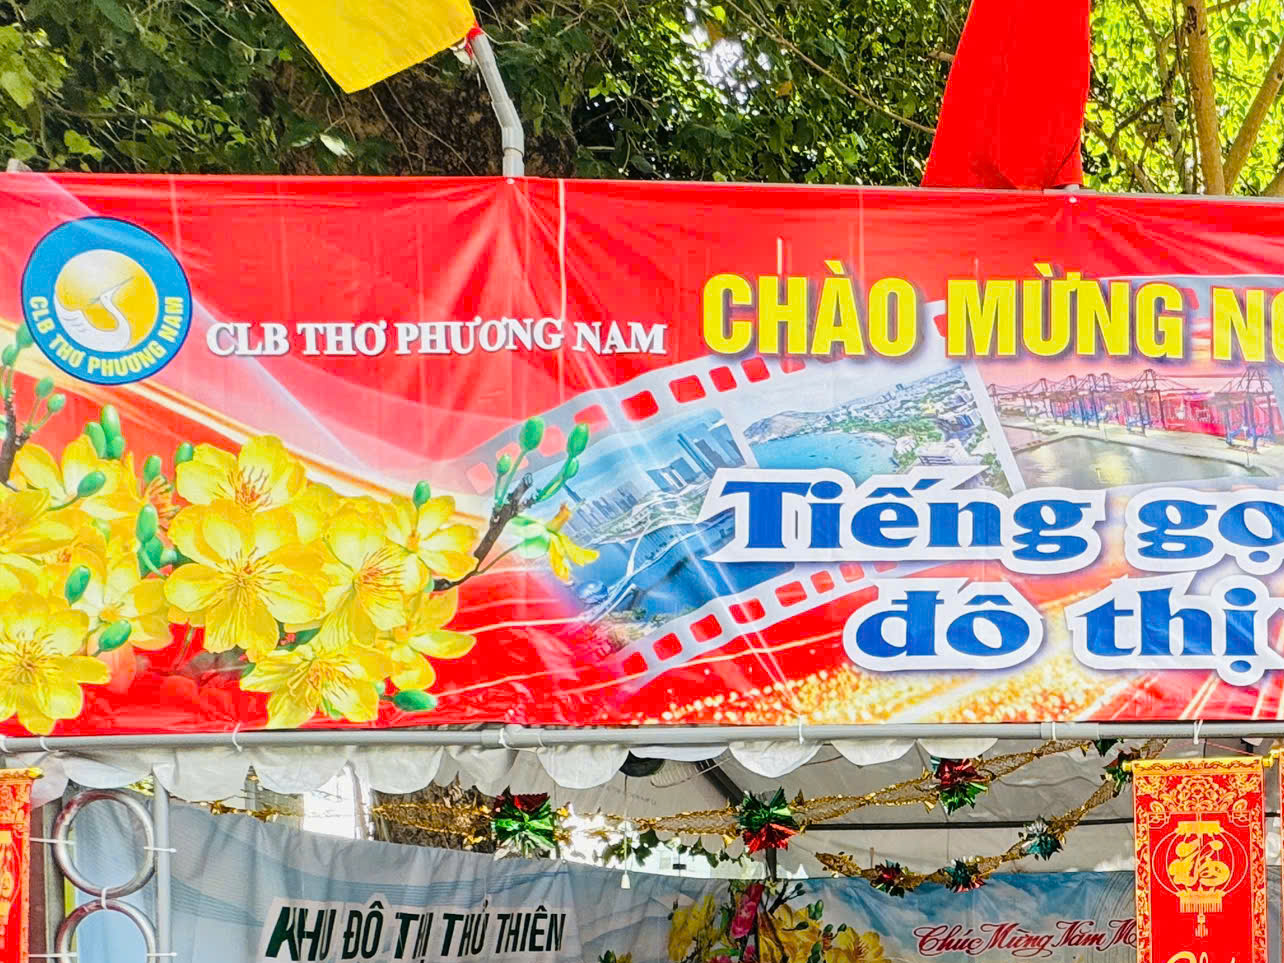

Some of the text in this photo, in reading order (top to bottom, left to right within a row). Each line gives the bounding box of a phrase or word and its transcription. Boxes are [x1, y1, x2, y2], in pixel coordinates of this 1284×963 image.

[29, 296, 55, 334] CLB
[49, 334, 86, 368] THƠ
[158, 296, 185, 343] NAM
[205, 314, 668, 357] CLB THƠ PHƯƠNG NAM
[701, 260, 918, 359] CHÀO
[946, 263, 1185, 361] MỪNG
[722, 476, 1093, 562] Tiếng
[854, 588, 1032, 660] đô
[1084, 585, 1264, 679] thị
[265, 906, 337, 962] KHU
[341, 900, 384, 960] ĐÔ
[440, 898, 490, 957] THỦ
[496, 904, 568, 953] THIÊN
[913, 924, 984, 957] Chúc
[979, 922, 1054, 958] Mừng
[1051, 919, 1107, 951] Năm
